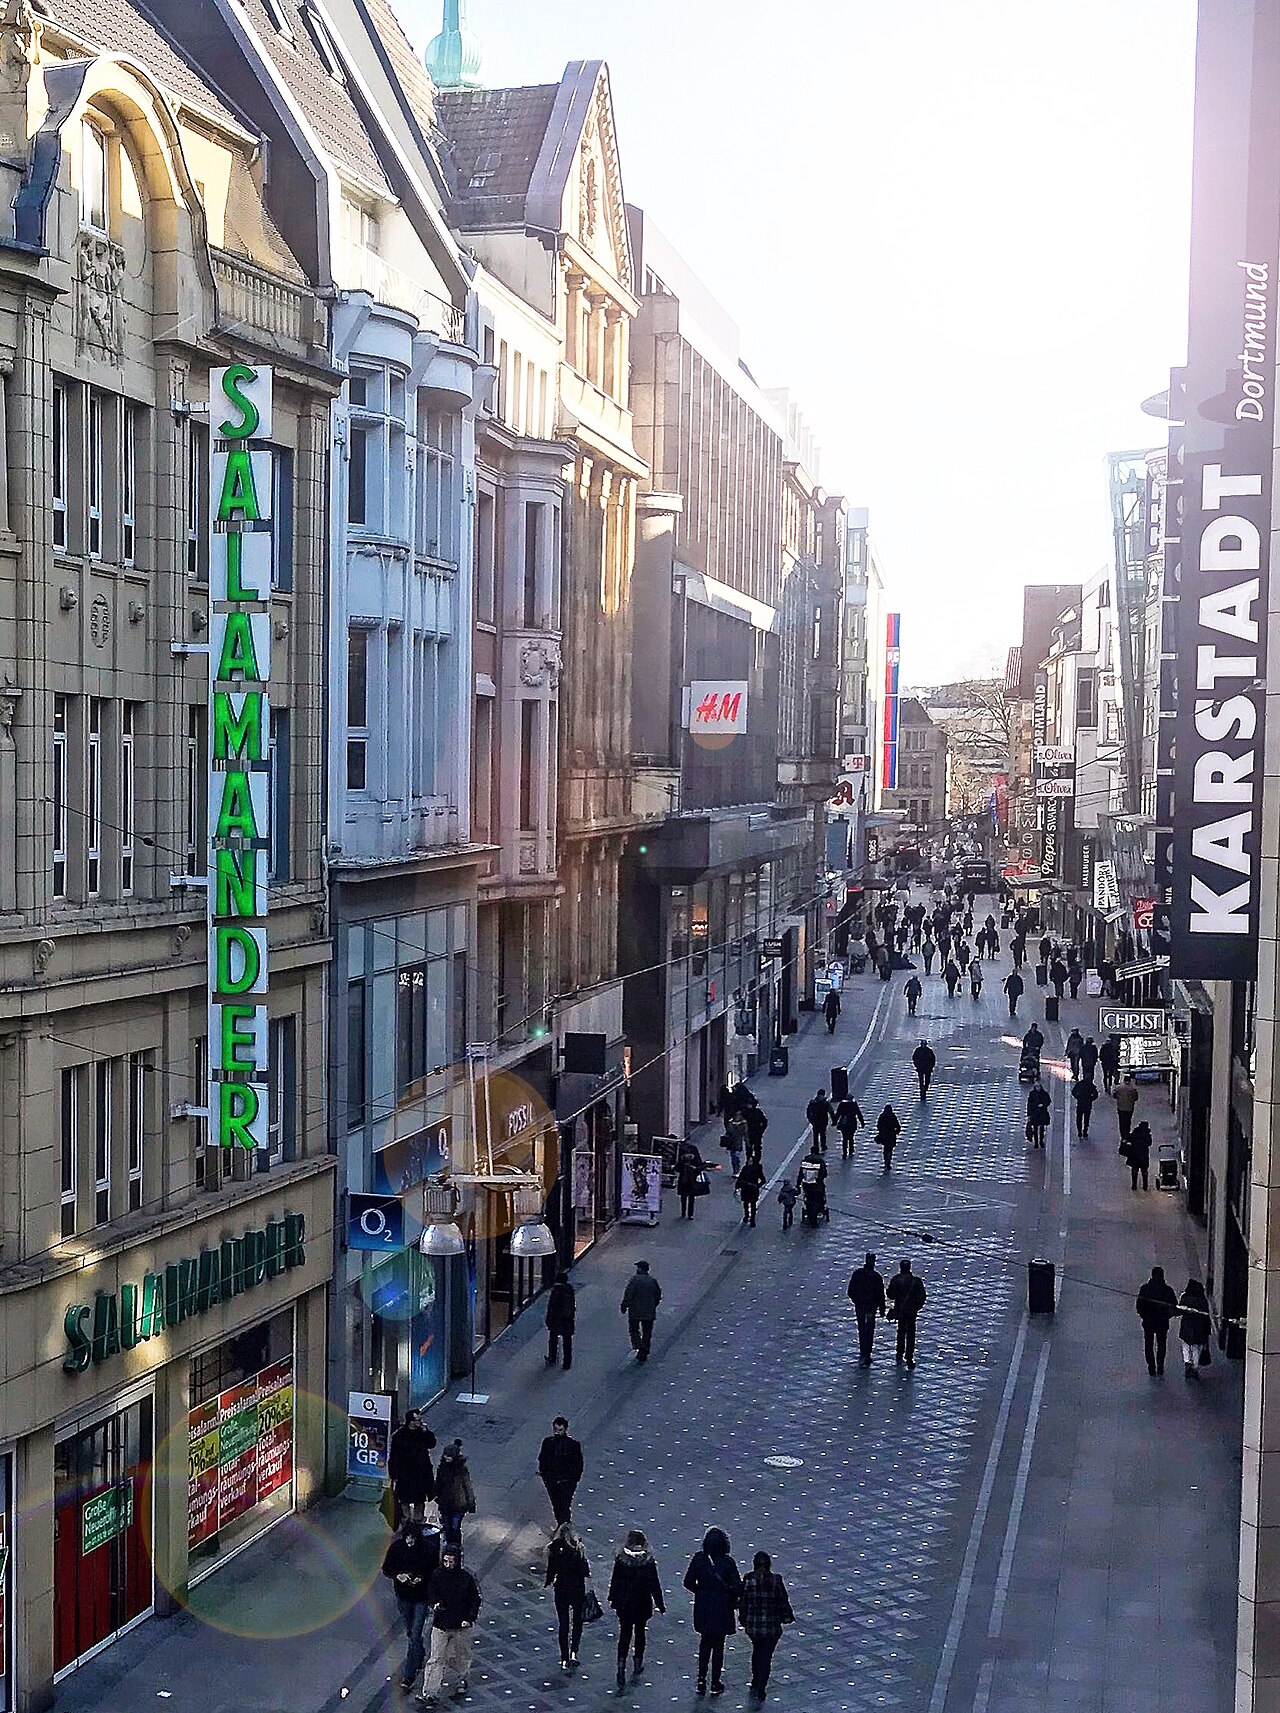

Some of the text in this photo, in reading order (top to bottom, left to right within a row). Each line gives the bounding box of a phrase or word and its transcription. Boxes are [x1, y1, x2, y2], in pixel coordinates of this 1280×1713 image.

[1235, 261, 1268, 422] Dortmund
[695, 692, 742, 723] H&M
[1189, 464, 1262, 935] KARSTADT
[214, 363, 262, 1150] SALAMANDER
[1103, 1013, 1161, 1030] CHRIST
[62, 1212, 306, 1373] SALAMANDER
[351, 1432, 369, 1449] 10
[356, 1449, 380, 1466] GB
